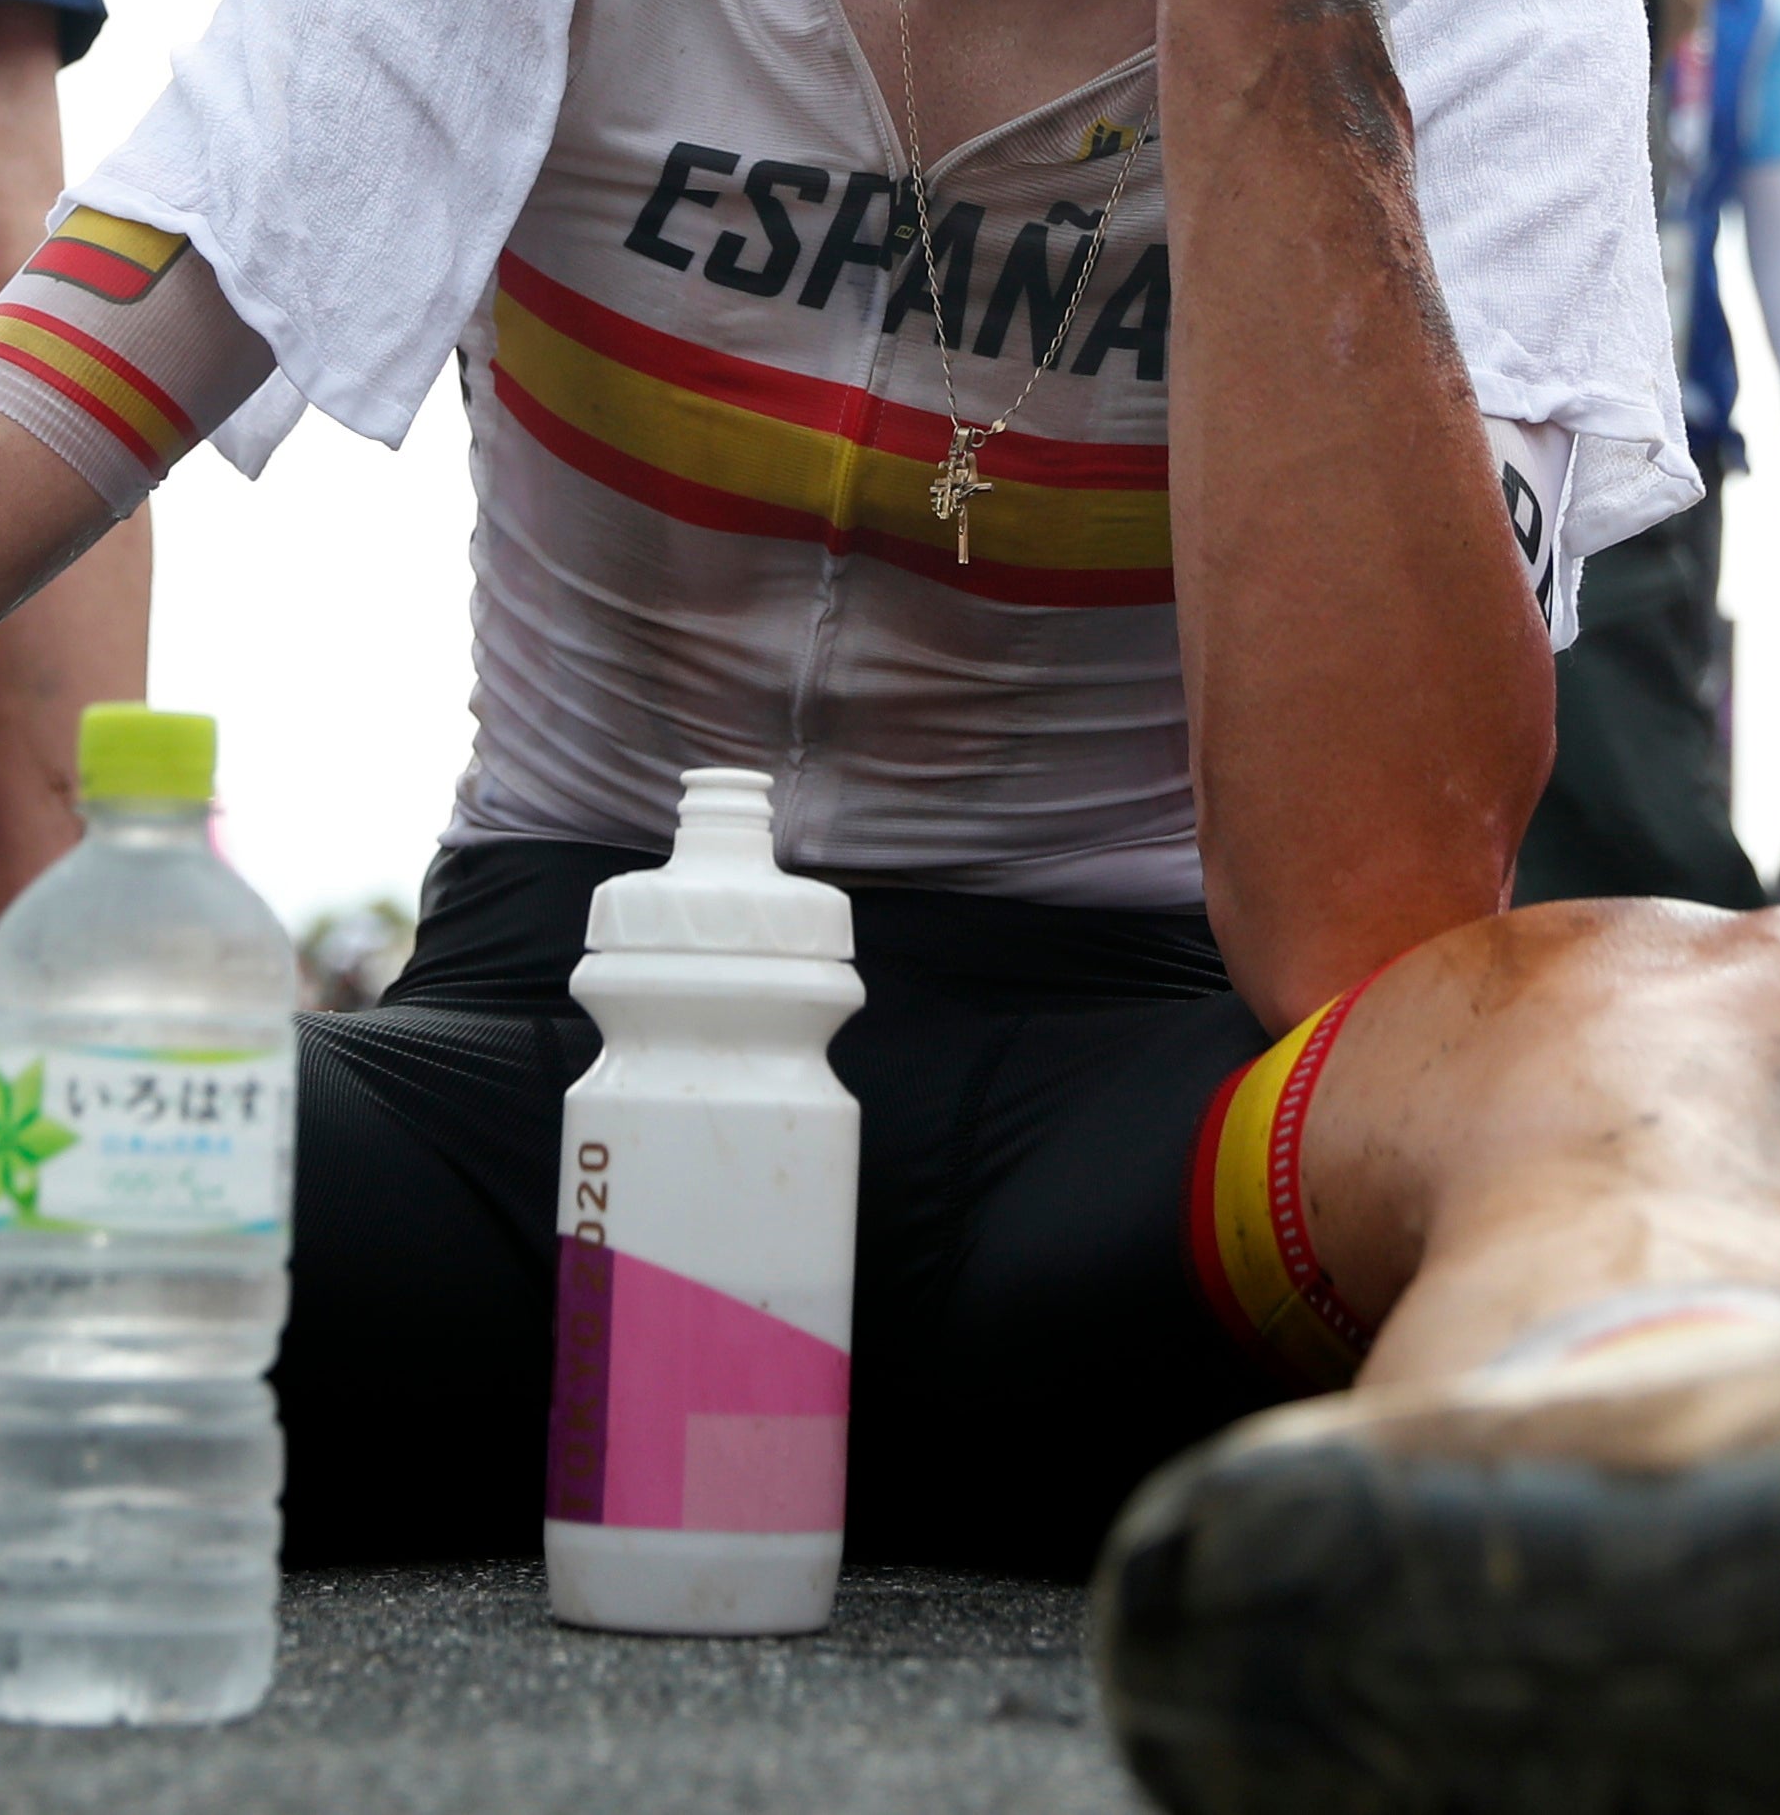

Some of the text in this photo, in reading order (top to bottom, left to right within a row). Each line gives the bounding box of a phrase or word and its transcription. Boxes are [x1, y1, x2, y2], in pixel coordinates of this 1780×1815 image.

[623, 141, 1171, 381] ESPAÑA
[65, 1072, 263, 1120] いろはす
[559, 1140, 610, 1516] TOKYO 2020
